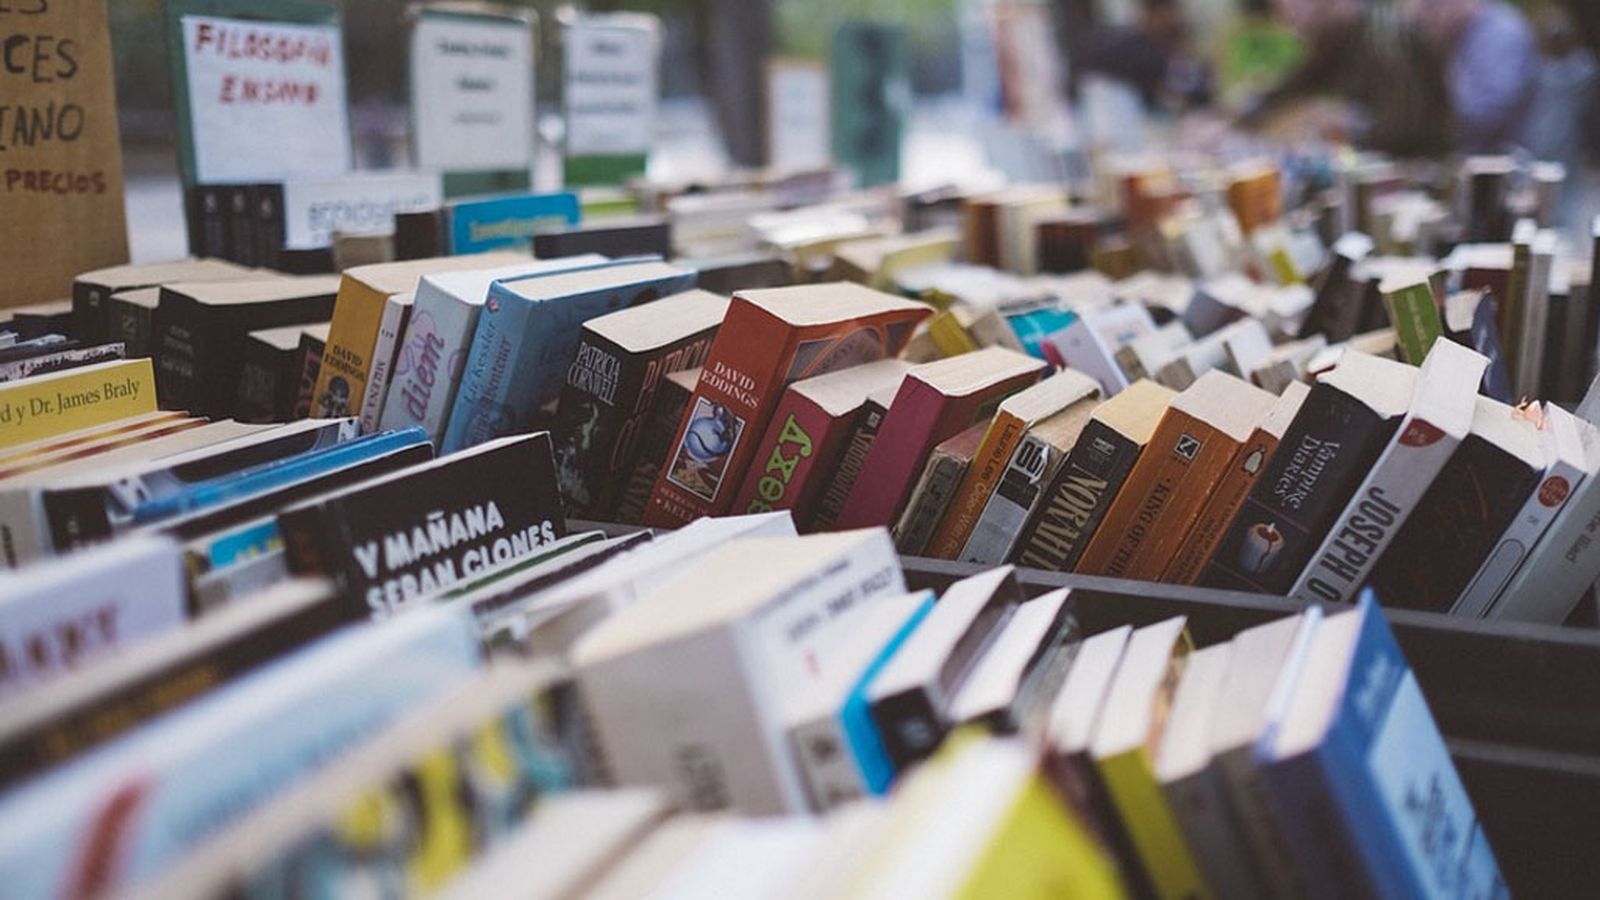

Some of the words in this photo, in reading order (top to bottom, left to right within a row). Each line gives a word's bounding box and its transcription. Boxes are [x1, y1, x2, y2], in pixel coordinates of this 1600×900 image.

[5, 169, 107, 195] PRECIOS
[471, 319, 498, 379] Kessler
[575, 341, 622, 383] PATRICIA
[401, 332, 445, 422] diem
[567, 361, 619, 406] CORNWELL
[700, 370, 760, 409] EDDINGS
[713, 361, 756, 391] DAVID
[16, 405, 25, 425] y
[29, 397, 54, 416] Dr.
[57, 390, 101, 414] James
[104, 378, 140, 400] Braly
[981, 456, 999, 481] Lee
[1030, 463, 1108, 560] NORAH
[1140, 482, 1170, 525] KING
[384, 501, 505, 571] MAÑANA
[462, 519, 559, 577] CLONES
[1127, 524, 1146, 549] OF
[1319, 485, 1401, 584] JOSEPH
